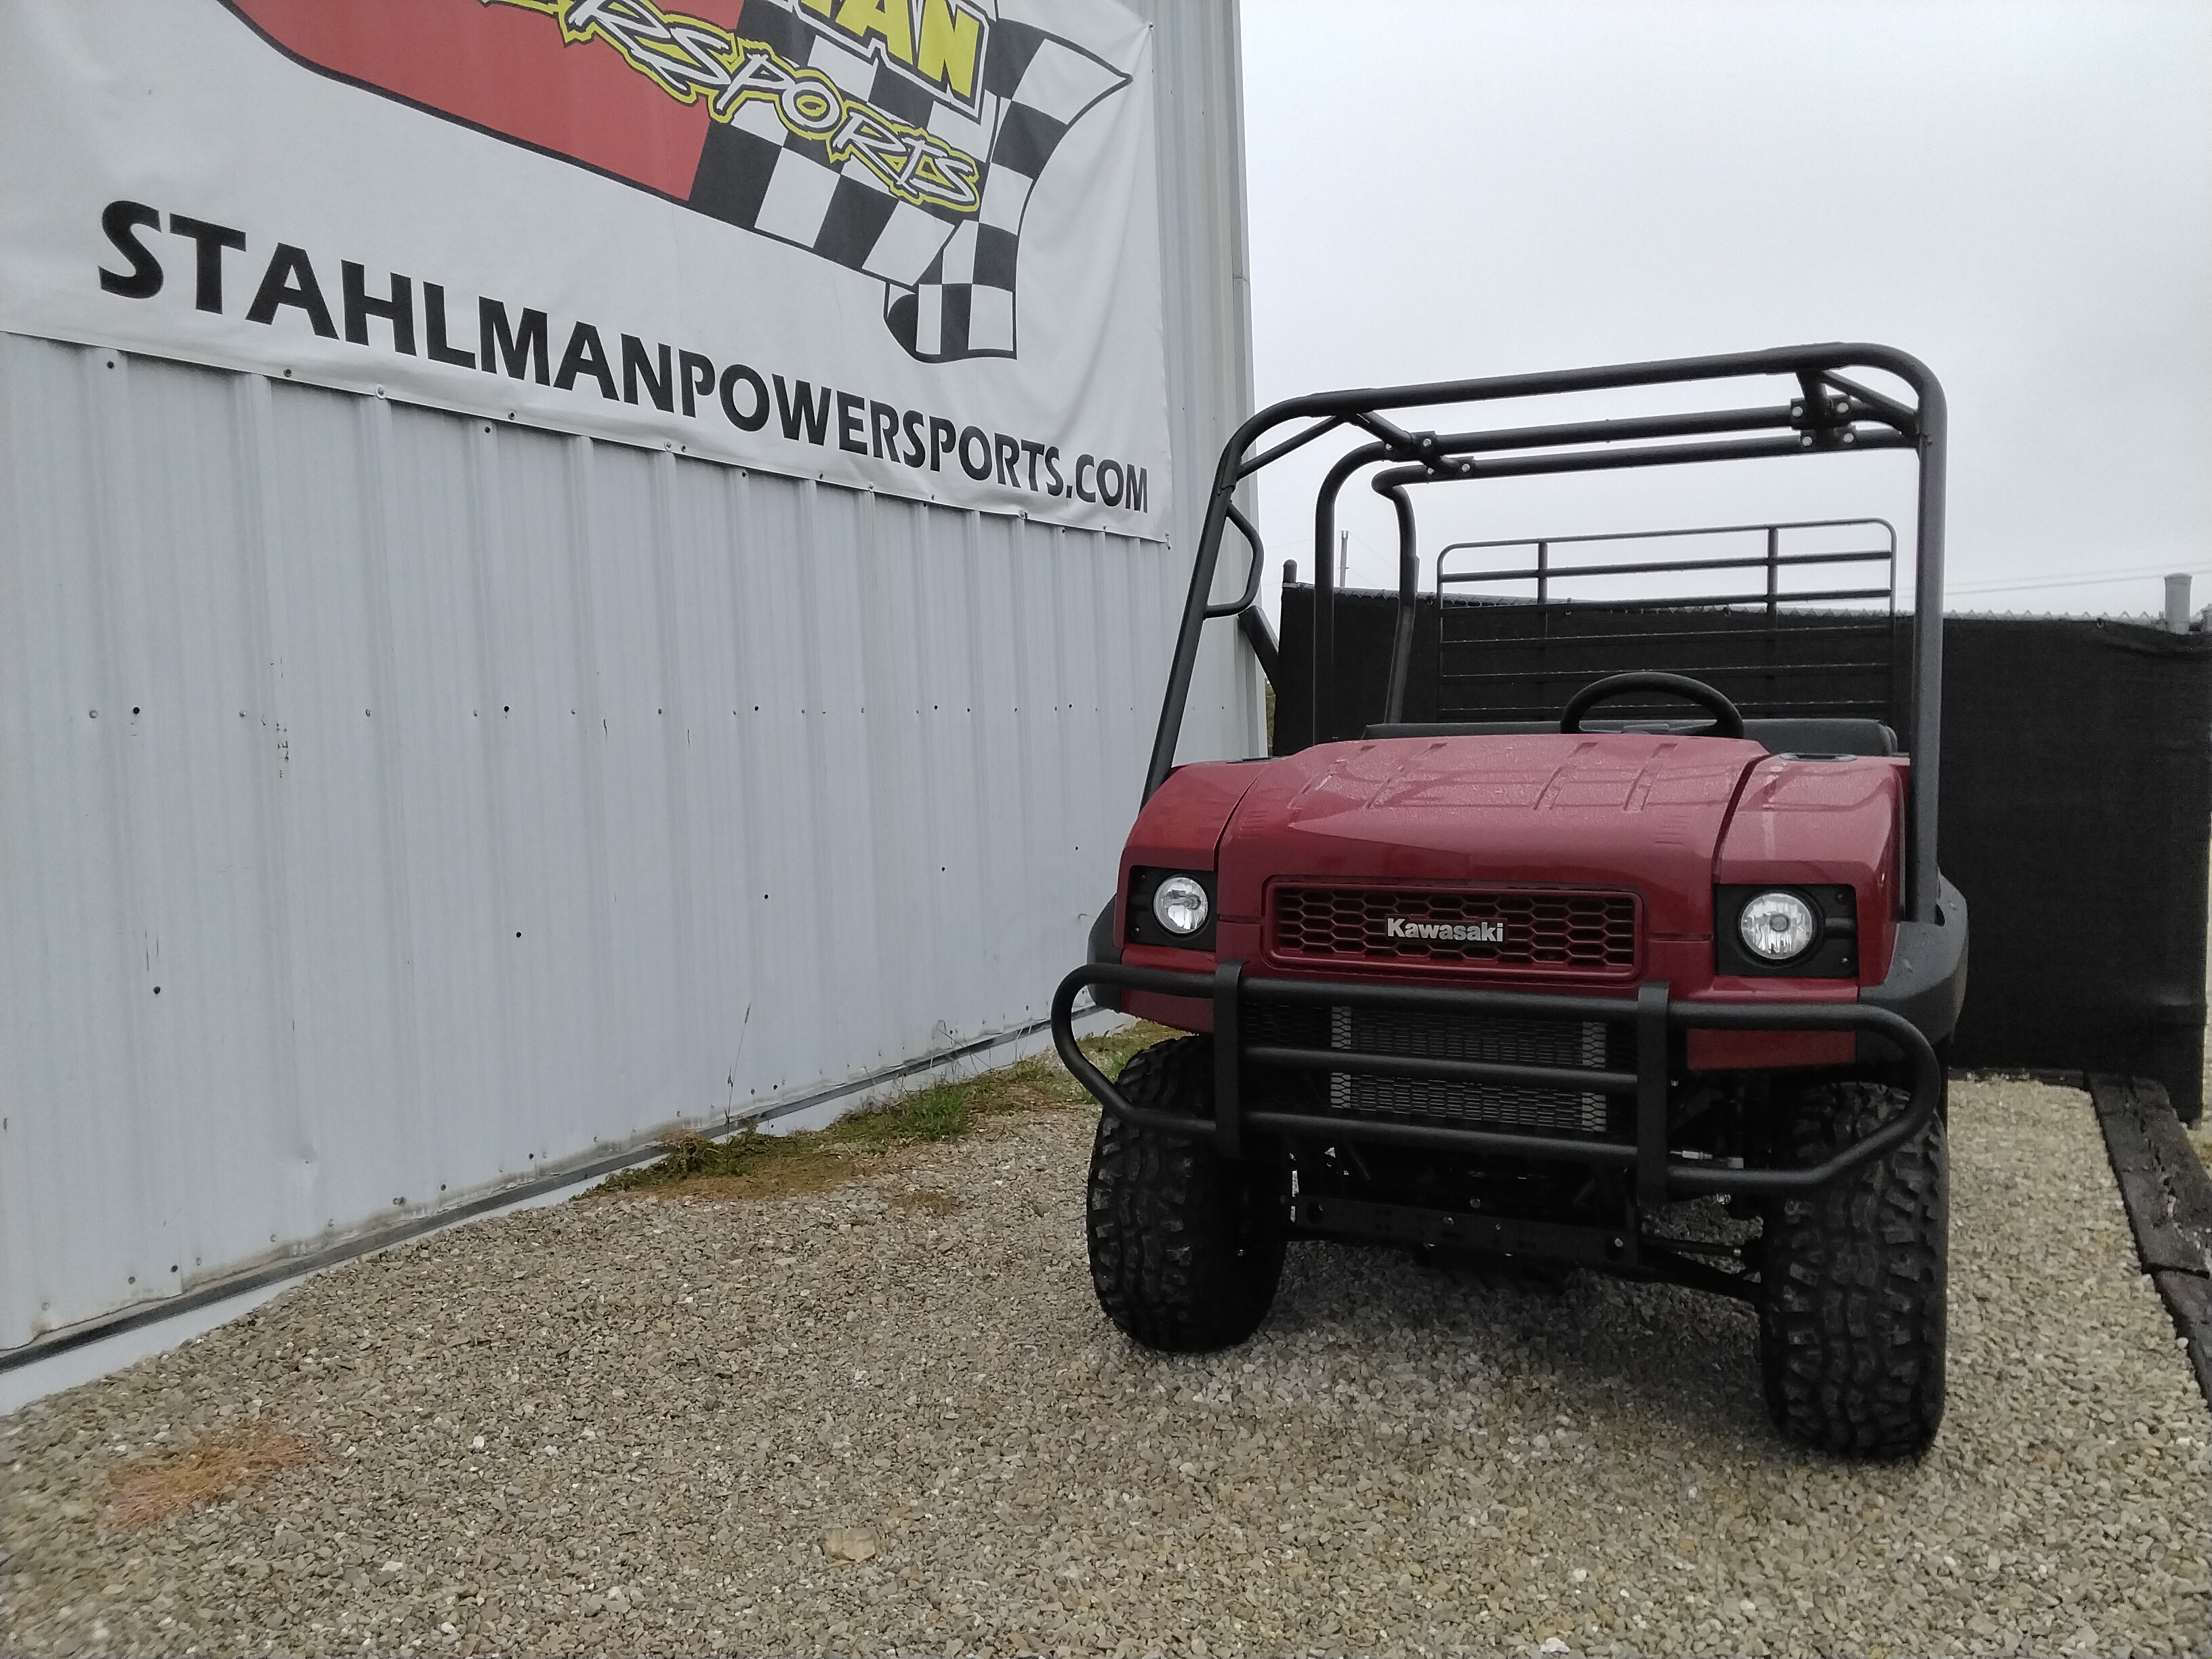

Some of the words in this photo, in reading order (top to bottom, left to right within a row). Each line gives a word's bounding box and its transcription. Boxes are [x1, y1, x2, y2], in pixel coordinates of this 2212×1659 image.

[560, 0, 978, 209] RSPORTS
[800, 0, 979, 98] AN
[98, 200, 1148, 513] STAHLMANPOWERSPORTS.COM
[1387, 918, 1504, 942] Kawasaki
